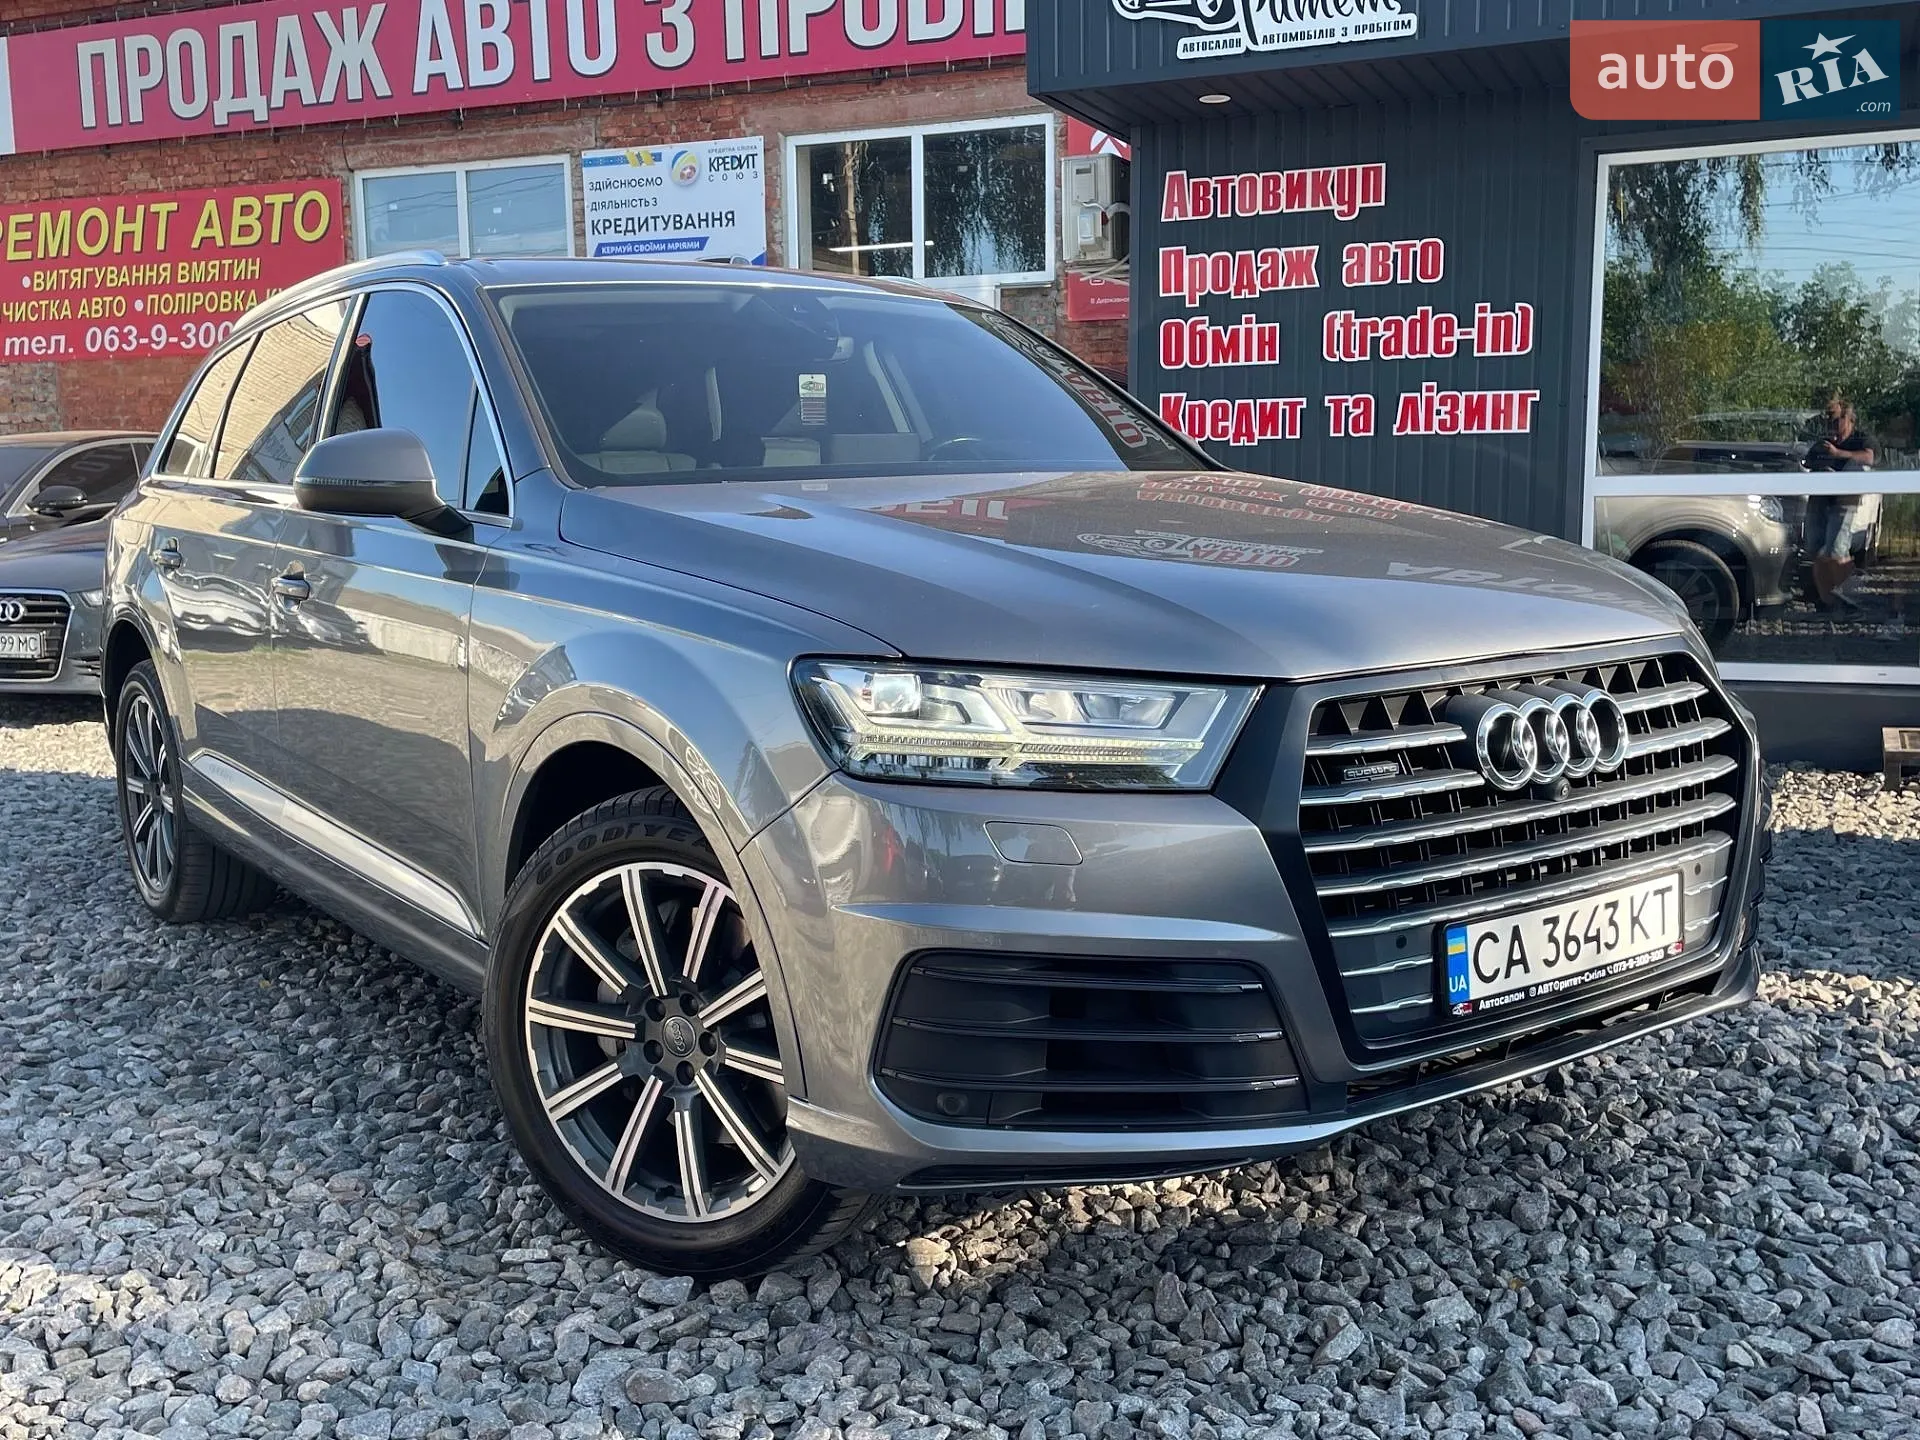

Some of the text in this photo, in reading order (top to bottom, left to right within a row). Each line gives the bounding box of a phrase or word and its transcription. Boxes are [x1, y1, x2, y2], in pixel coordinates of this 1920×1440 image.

[1182, 19, 1412, 53] АВТОСАЛОН АВТОМОБІЛІВ З ПРОБІГОМ
[77, 3, 391, 129] ПРОДАЖ
[412, 0, 617, 94] АВТО
[589, 176, 663, 192] ЗДІЙСНЮЄМО
[1160, 163, 1387, 222] Автовикуп
[590, 197, 658, 212] ДІЯЛЬНІСТЬ З
[0, 190, 330, 261] ЕМОНТ АВТО
[592, 211, 736, 236] КРЕДИТУВАННЯ
[601, 240, 700, 254] КЕРМУЙ СВОЇМИ МРІЯМИ
[33, 257, 262, 292] ВИТЯГУВАННЯ ВМЯТИН
[1159, 238, 1444, 307] Продаж авто
[78, 295, 126, 319] АВТО
[147, 289, 257, 316] ПОЛІРОВКА
[5, 333, 74, 356] тел.
[1159, 303, 1535, 369] Обмін (trade-in)
[1159, 382, 1540, 446] Кредит та лізинг
[1347, 765, 1397, 778] quattro
[1472, 886, 1674, 984] CA 3643 KT
[1449, 977, 1467, 993] UA
[1479, 991, 1525, 1010] Автосалон
